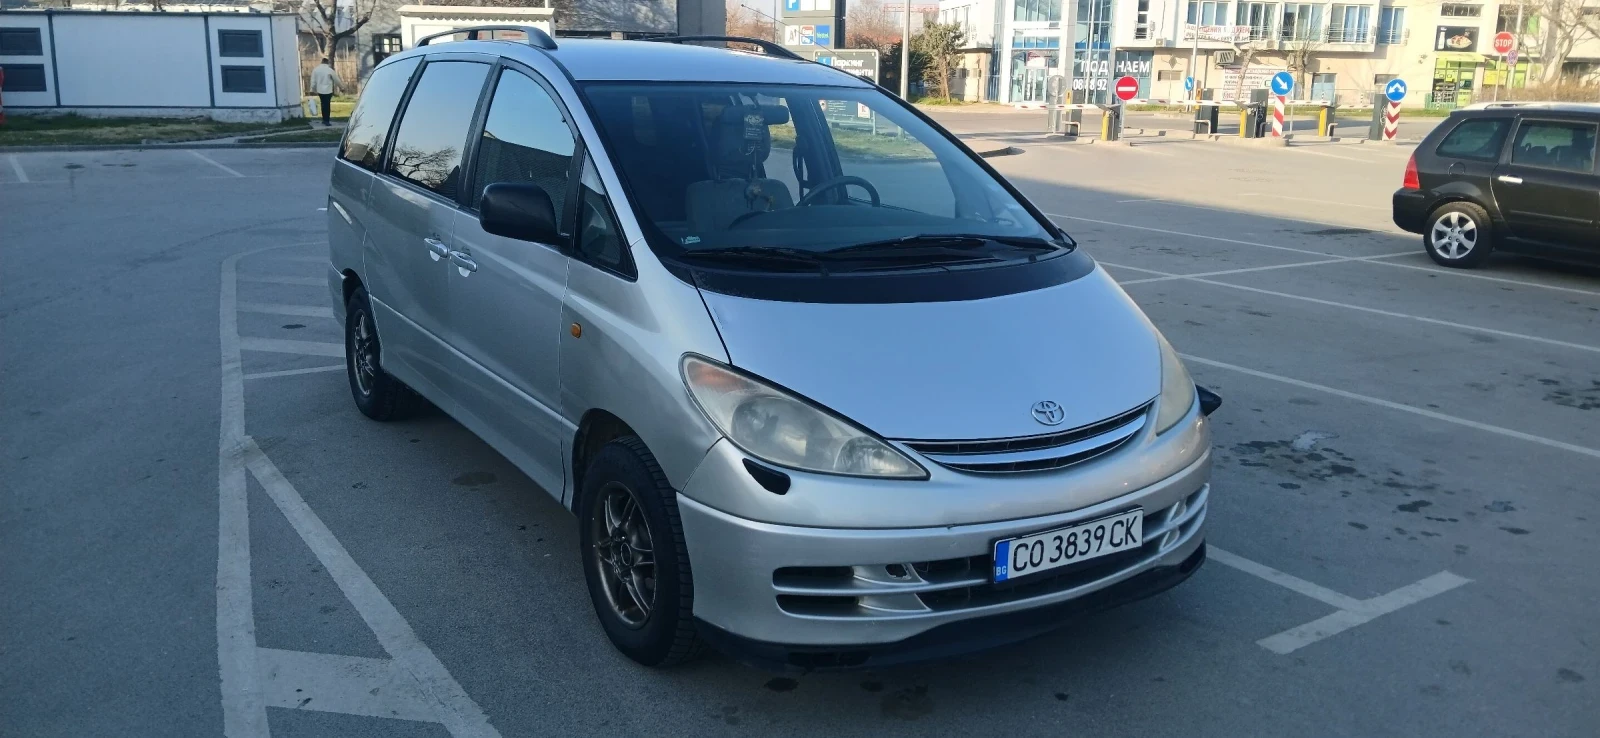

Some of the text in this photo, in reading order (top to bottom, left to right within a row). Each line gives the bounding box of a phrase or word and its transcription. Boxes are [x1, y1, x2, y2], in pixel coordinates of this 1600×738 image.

[1495, 39, 1512, 47] STOP
[831, 57, 864, 69] Паркинг
[1081, 60, 1149, 75] ПОД НАЕМ
[1013, 515, 1138, 572] CO 3839 CK
[996, 565, 1007, 575] BG
